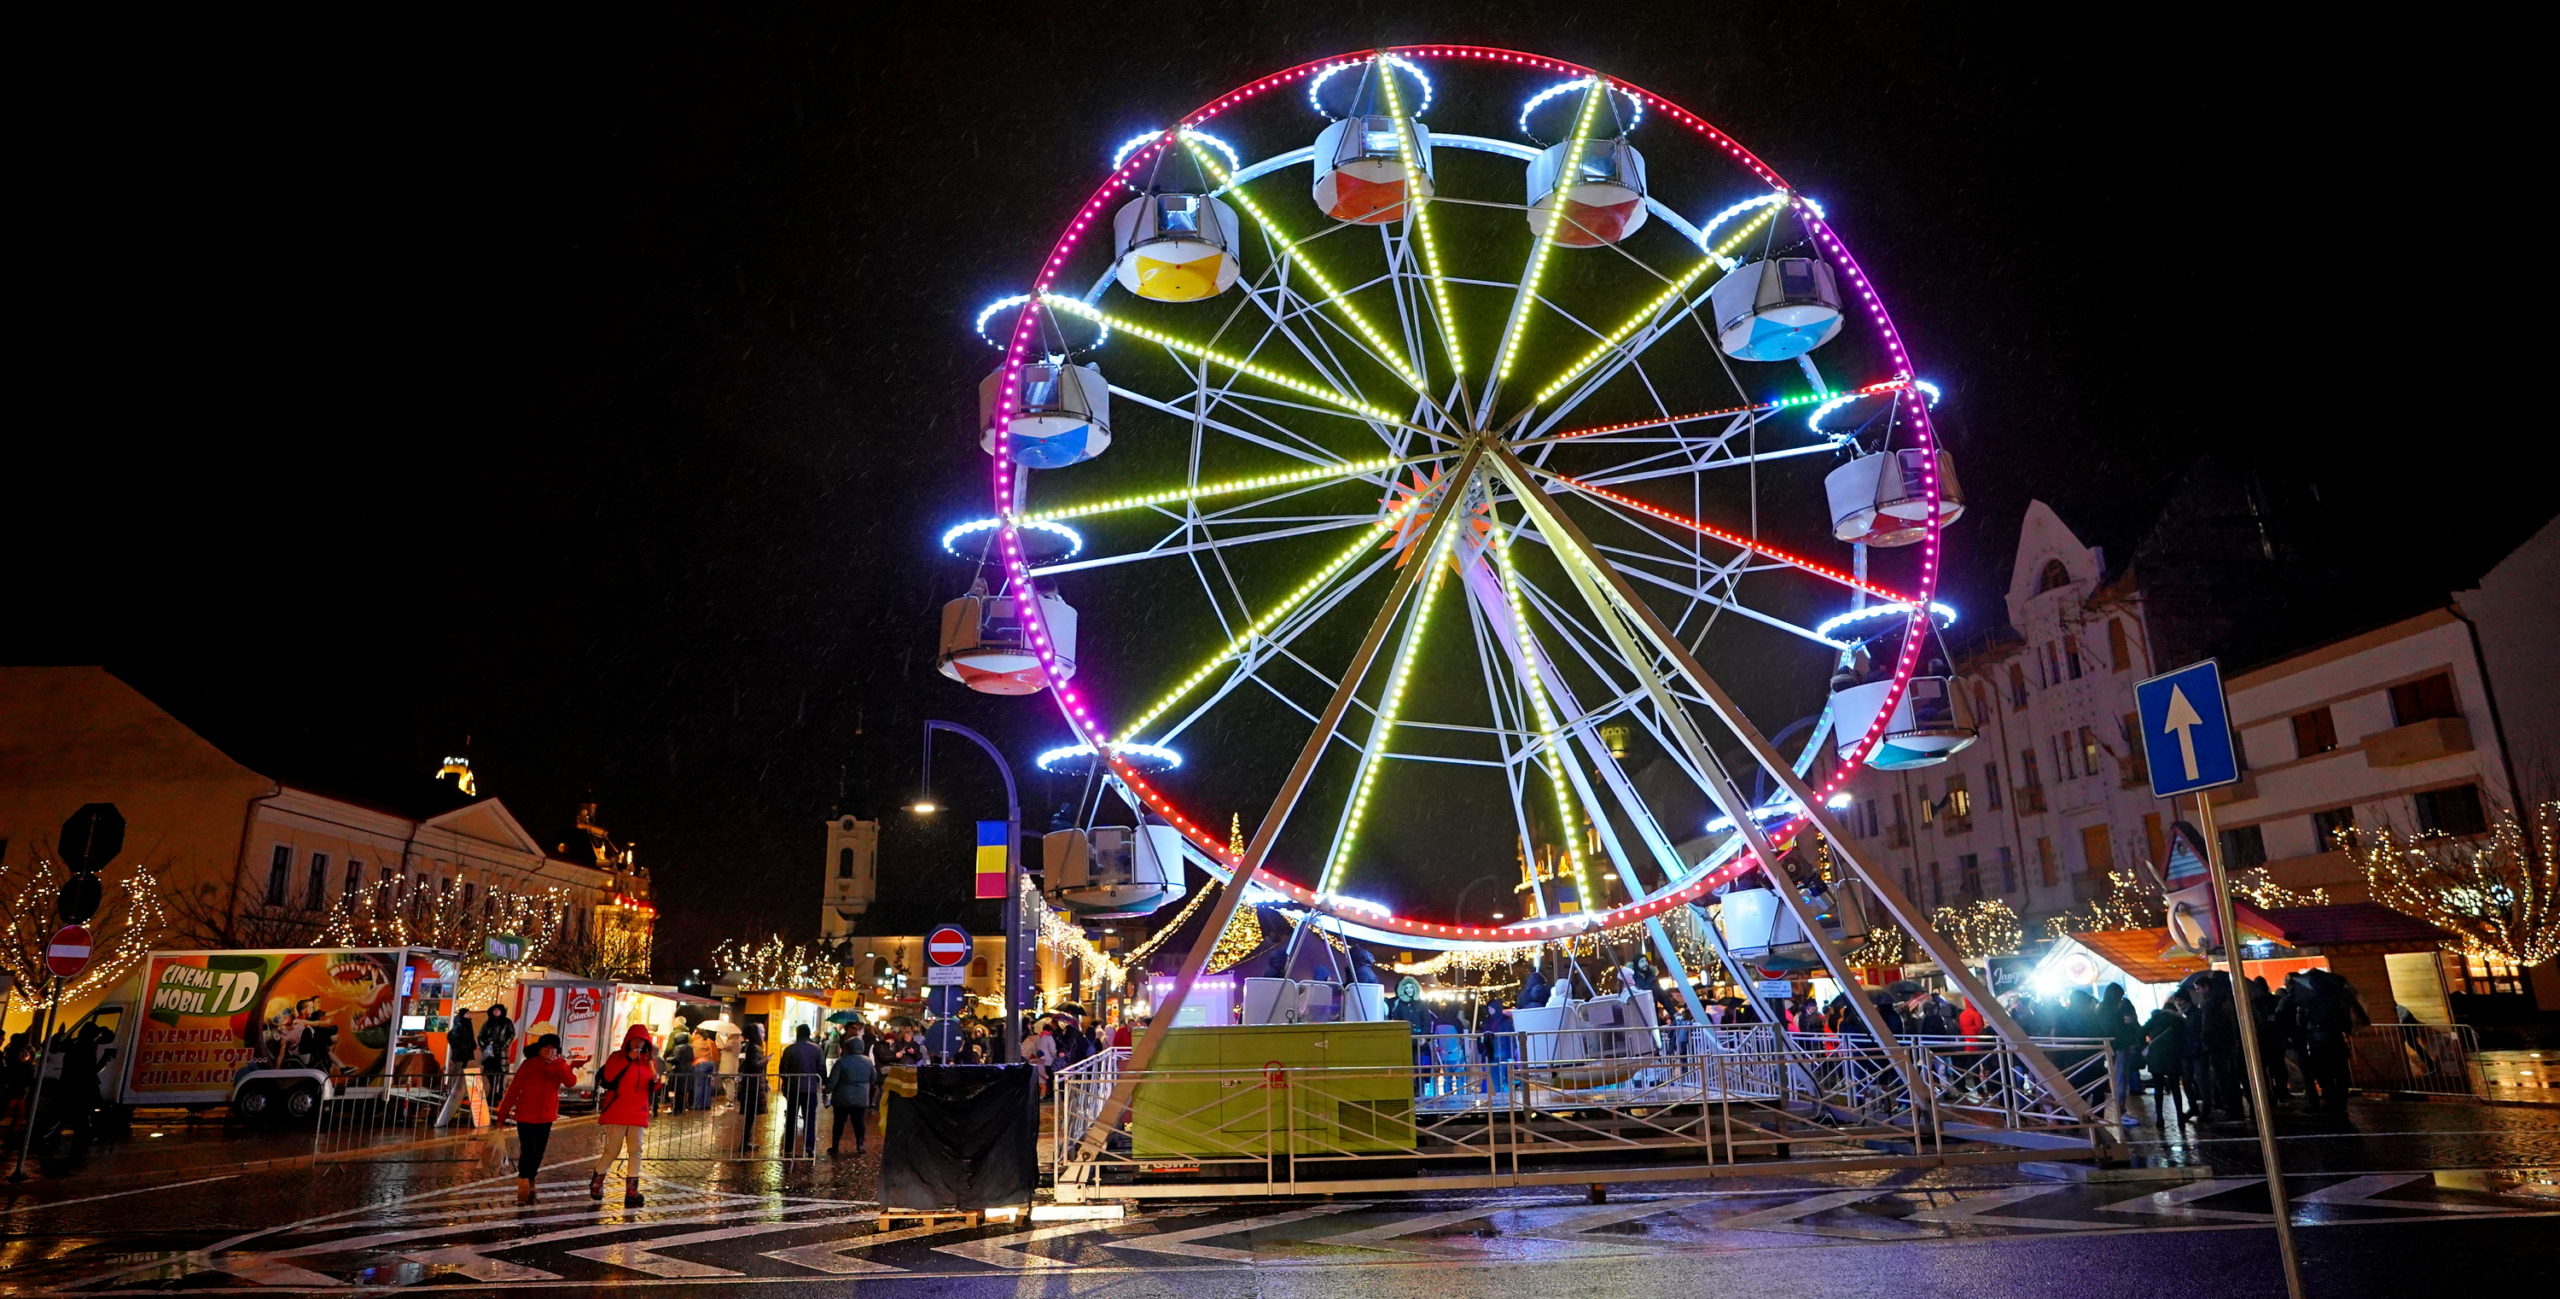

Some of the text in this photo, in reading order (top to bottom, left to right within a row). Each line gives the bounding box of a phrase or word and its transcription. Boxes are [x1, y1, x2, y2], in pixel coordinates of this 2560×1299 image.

[1377, 159, 1383, 169] 5
[161, 964, 260, 1014] CINEMA 7D
[152, 987, 206, 1014] MOBIL
[143, 1028, 234, 1045] AVENTURA
[140, 1049, 210, 1065] PENTRU
[138, 1070, 193, 1087] CHIAR
